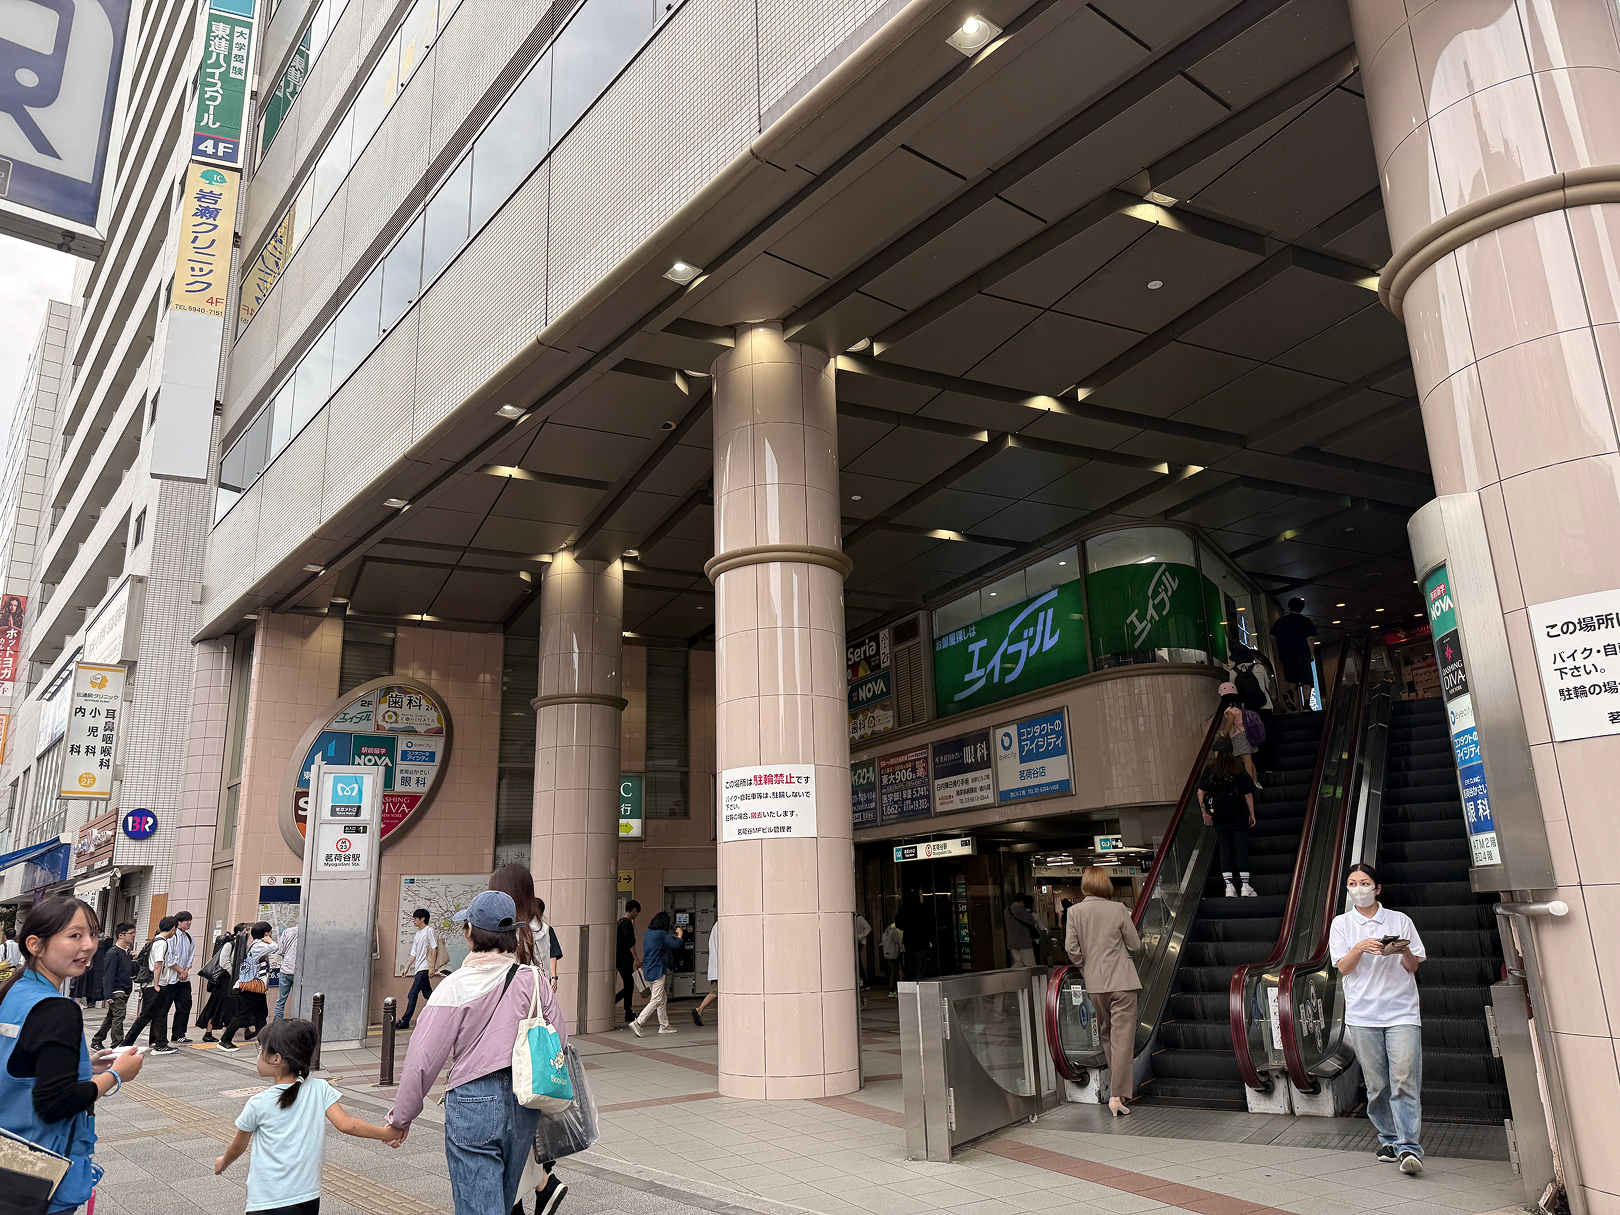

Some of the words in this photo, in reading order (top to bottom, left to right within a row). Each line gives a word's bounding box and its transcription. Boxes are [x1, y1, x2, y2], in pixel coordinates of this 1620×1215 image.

[230, 29, 248, 77] 大学受験
[200, 21, 230, 129] 東進ハイスクール
[198, 138, 234, 156] 4F
[213, 174, 223, 182] IC
[185, 188, 224, 294] 岩瀬クリニック
[206, 296, 224, 306] 4F
[1126, 564, 1179, 648] エイブル
[1430, 595, 1454, 620] NOVA
[935, 625, 976, 651] お部屋探しは
[954, 588, 1061, 702] エイブル
[1, 628, 18, 680] ホットヨガ
[847, 638, 877, 665] Seria
[1552, 642, 1620, 665] バイク・自
[1443, 669, 1466, 690] DIVA
[1554, 663, 1606, 681] 下さい。
[858, 678, 887, 702] NOVA
[1558, 681, 1620, 702] 駐輪の場
[388, 694, 422, 710] 歯科
[335, 711, 373, 724] エイブル
[85, 706, 101, 756] 小児科
[98, 708, 117, 770] 耳鼻咽喉科
[1020, 719, 1062, 740] コンタクトの
[963, 740, 988, 765] 眼科
[1021, 735, 1063, 756] アイシティ
[355, 755, 393, 767] NOVA
[80, 778, 94, 786] 2F
[401, 776, 426, 787] 眼科
[620, 782, 633, 798] C
[725, 773, 811, 789] この場所は駐輪禁止です
[620, 803, 632, 815] 行
[1467, 798, 1490, 823] 眼科
[324, 853, 360, 862] 茗荷谷駅
